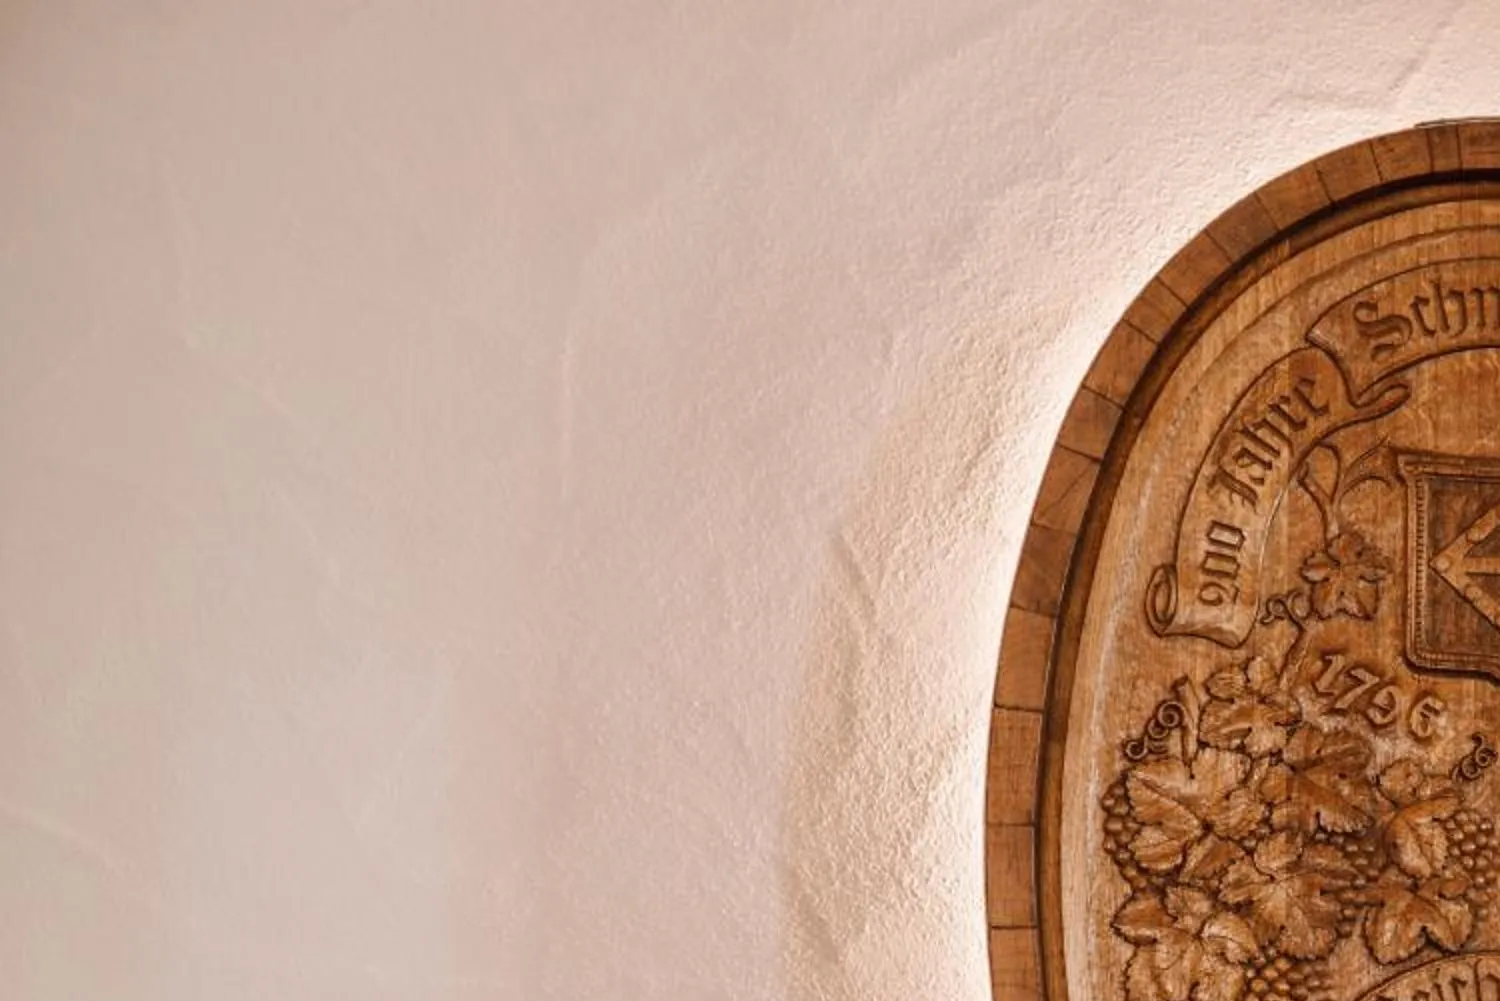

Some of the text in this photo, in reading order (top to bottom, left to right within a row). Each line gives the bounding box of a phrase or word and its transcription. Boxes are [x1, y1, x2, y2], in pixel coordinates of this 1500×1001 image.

[1206, 376, 1330, 514] Jahre
[1197, 519, 1246, 607] 200
[1313, 652, 1446, 741] 1796
